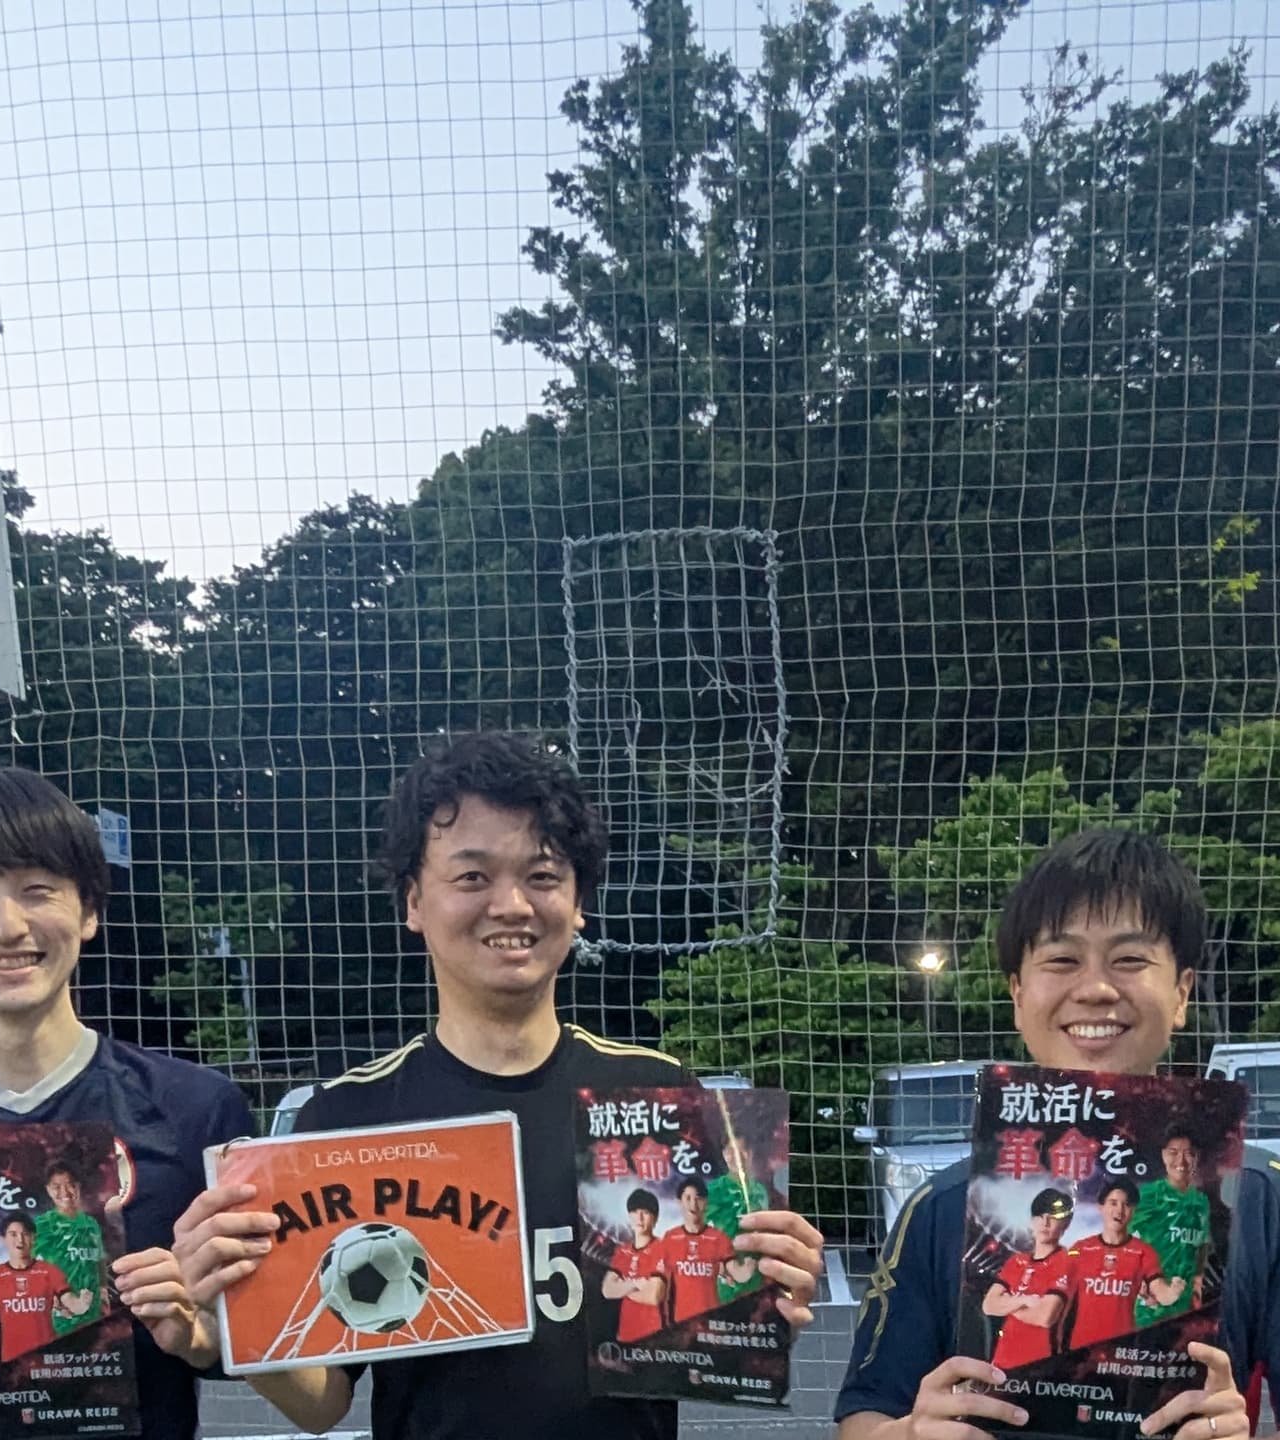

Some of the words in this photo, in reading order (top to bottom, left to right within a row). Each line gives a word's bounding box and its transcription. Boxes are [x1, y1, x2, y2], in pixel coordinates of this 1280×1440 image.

[999, 1082, 1116, 1124] 就活に
[588, 1099, 680, 1137] 就活に
[591, 1138, 712, 1182] 革命を。
[992, 1127, 1149, 1182] 革命を。
[271, 1184, 358, 1243] AIR
[373, 1178, 513, 1243] PLAY!
[533, 1226, 584, 1322] 5
[677, 1260, 713, 1277] POLUS
[1084, 1277, 1133, 1297] POLUS
[2, 1297, 46, 1312] POLUS
[1115, 1346, 1190, 1365] 就活フットサル
[741, 1376, 772, 1390] REDS
[38, 1409, 82, 1420] URAWA
[86, 1407, 119, 1417] REDS
[1095, 1410, 1143, 1423] URAWA
